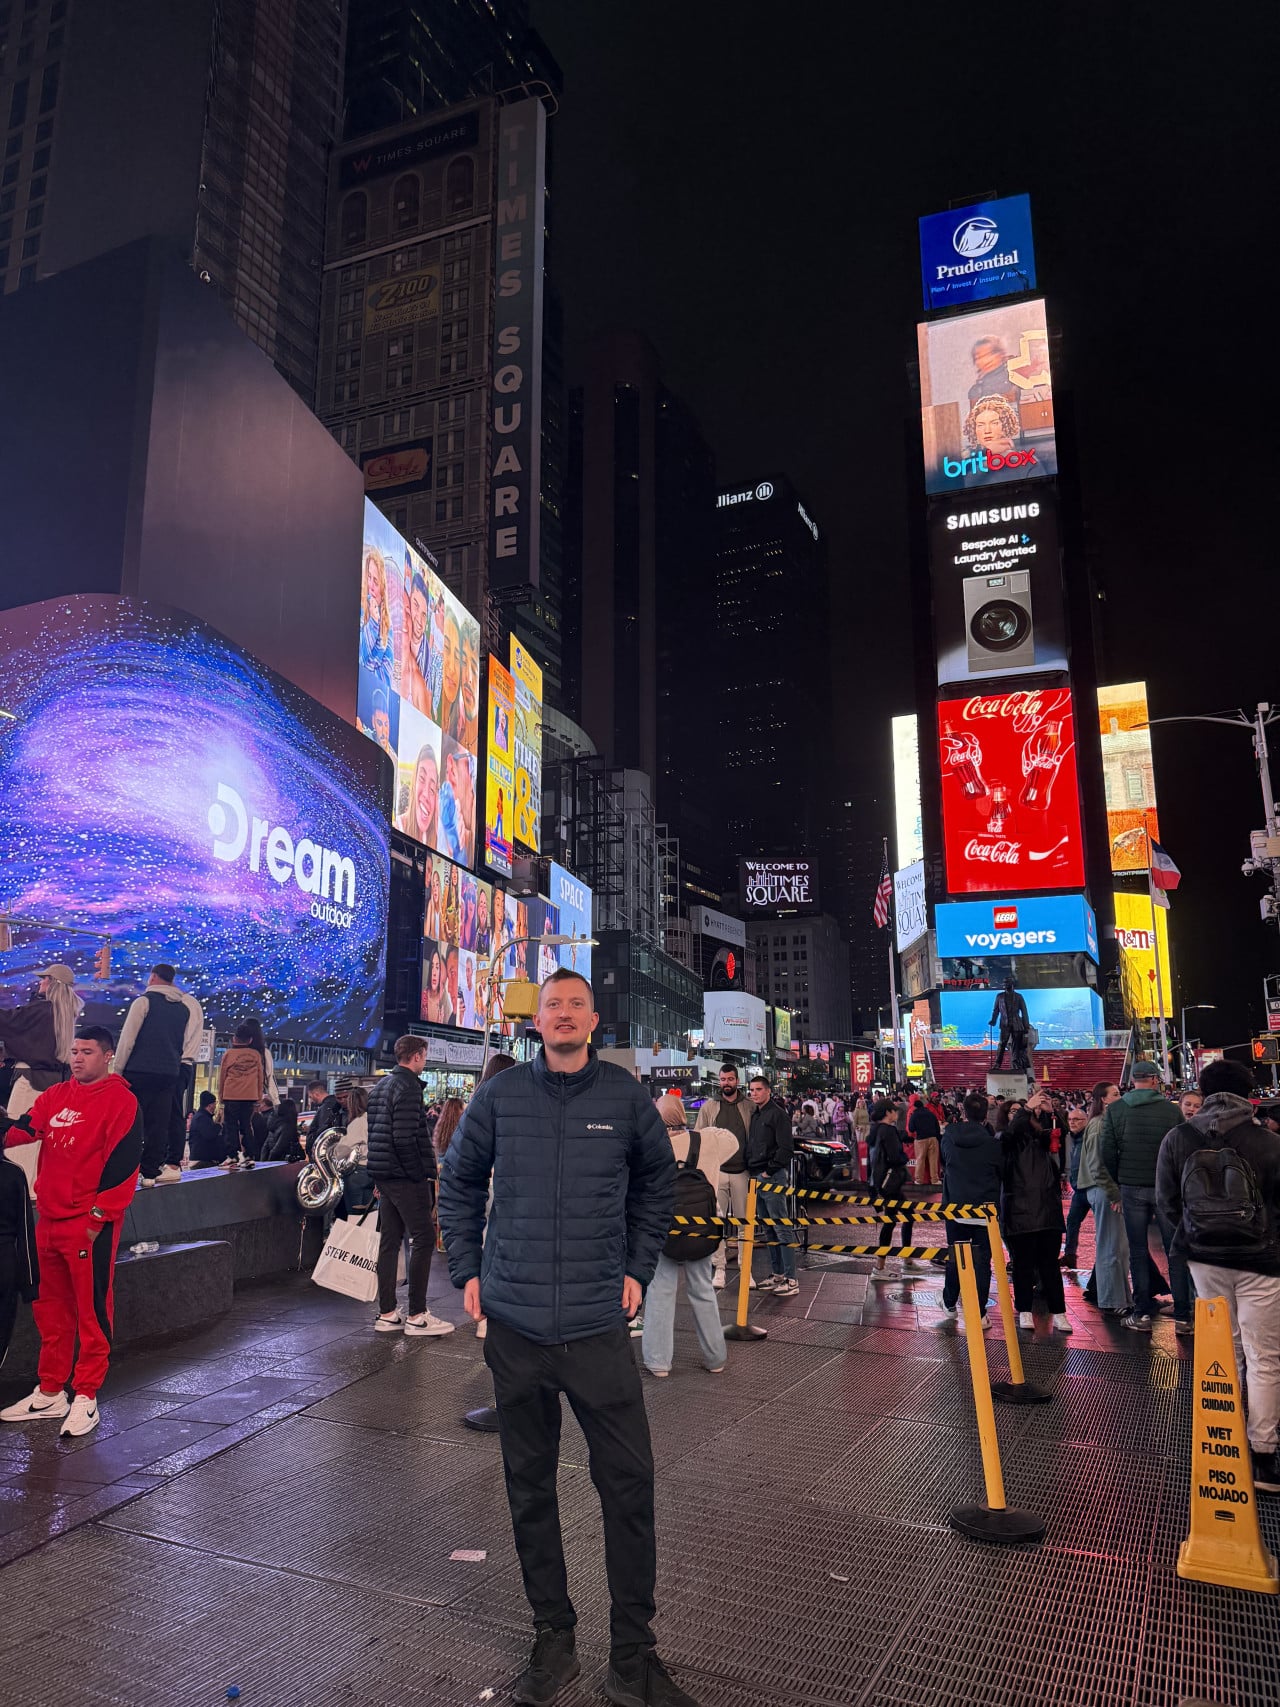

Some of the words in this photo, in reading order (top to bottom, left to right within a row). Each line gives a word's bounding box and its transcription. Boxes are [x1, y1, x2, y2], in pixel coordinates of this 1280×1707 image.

[377, 146, 413, 166] TIMES
[416, 127, 467, 150] SQUARE
[497, 125, 527, 297] TIMES
[936, 250, 1019, 279] Prudential
[376, 276, 431, 310] Z100
[931, 285, 946, 294] Plan
[952, 279, 972, 289] Invest
[979, 274, 1000, 284] Insure
[492, 326, 523, 559] SQUARE
[943, 448, 1036, 478] britbox
[716, 490, 753, 508] llianz
[947, 503, 1040, 530] SAMSUNG
[961, 536, 1007, 552] Bespoke
[1008, 534, 1018, 544] AI
[954, 550, 997, 565] Laundry
[999, 544, 1036, 559] Vented
[963, 690, 1043, 720] Coca-Cola
[207, 782, 356, 909] Dream
[964, 839, 1022, 864] Coca-Cola
[745, 861, 796, 871] WELCOME
[796, 863, 809, 871] TO
[773, 875, 809, 886] TIMES
[896, 873, 923, 891] WELCOME
[560, 877, 584, 912] SPACE
[746, 886, 813, 906] SQUARE.
[311, 902, 354, 929] outdoor
[994, 912, 1017, 924] LEGO
[965, 929, 1056, 951] voyagers
[269, 1040, 299, 1062] GLE
[300, 1042, 366, 1067] OUTFITTERS
[856, 1053, 870, 1083] tkts
[325, 1246, 349, 1261] STEVE
[349, 1255, 379, 1273] MADDE
[1201, 1380, 1233, 1395] CAUTION
[1201, 1397, 1235, 1413] CUIDADO
[1206, 1426, 1232, 1441] WET
[1201, 1442, 1240, 1459] FLOOR
[1208, 1469, 1236, 1485] PISO
[1199, 1485, 1249, 1505] MOJADO
